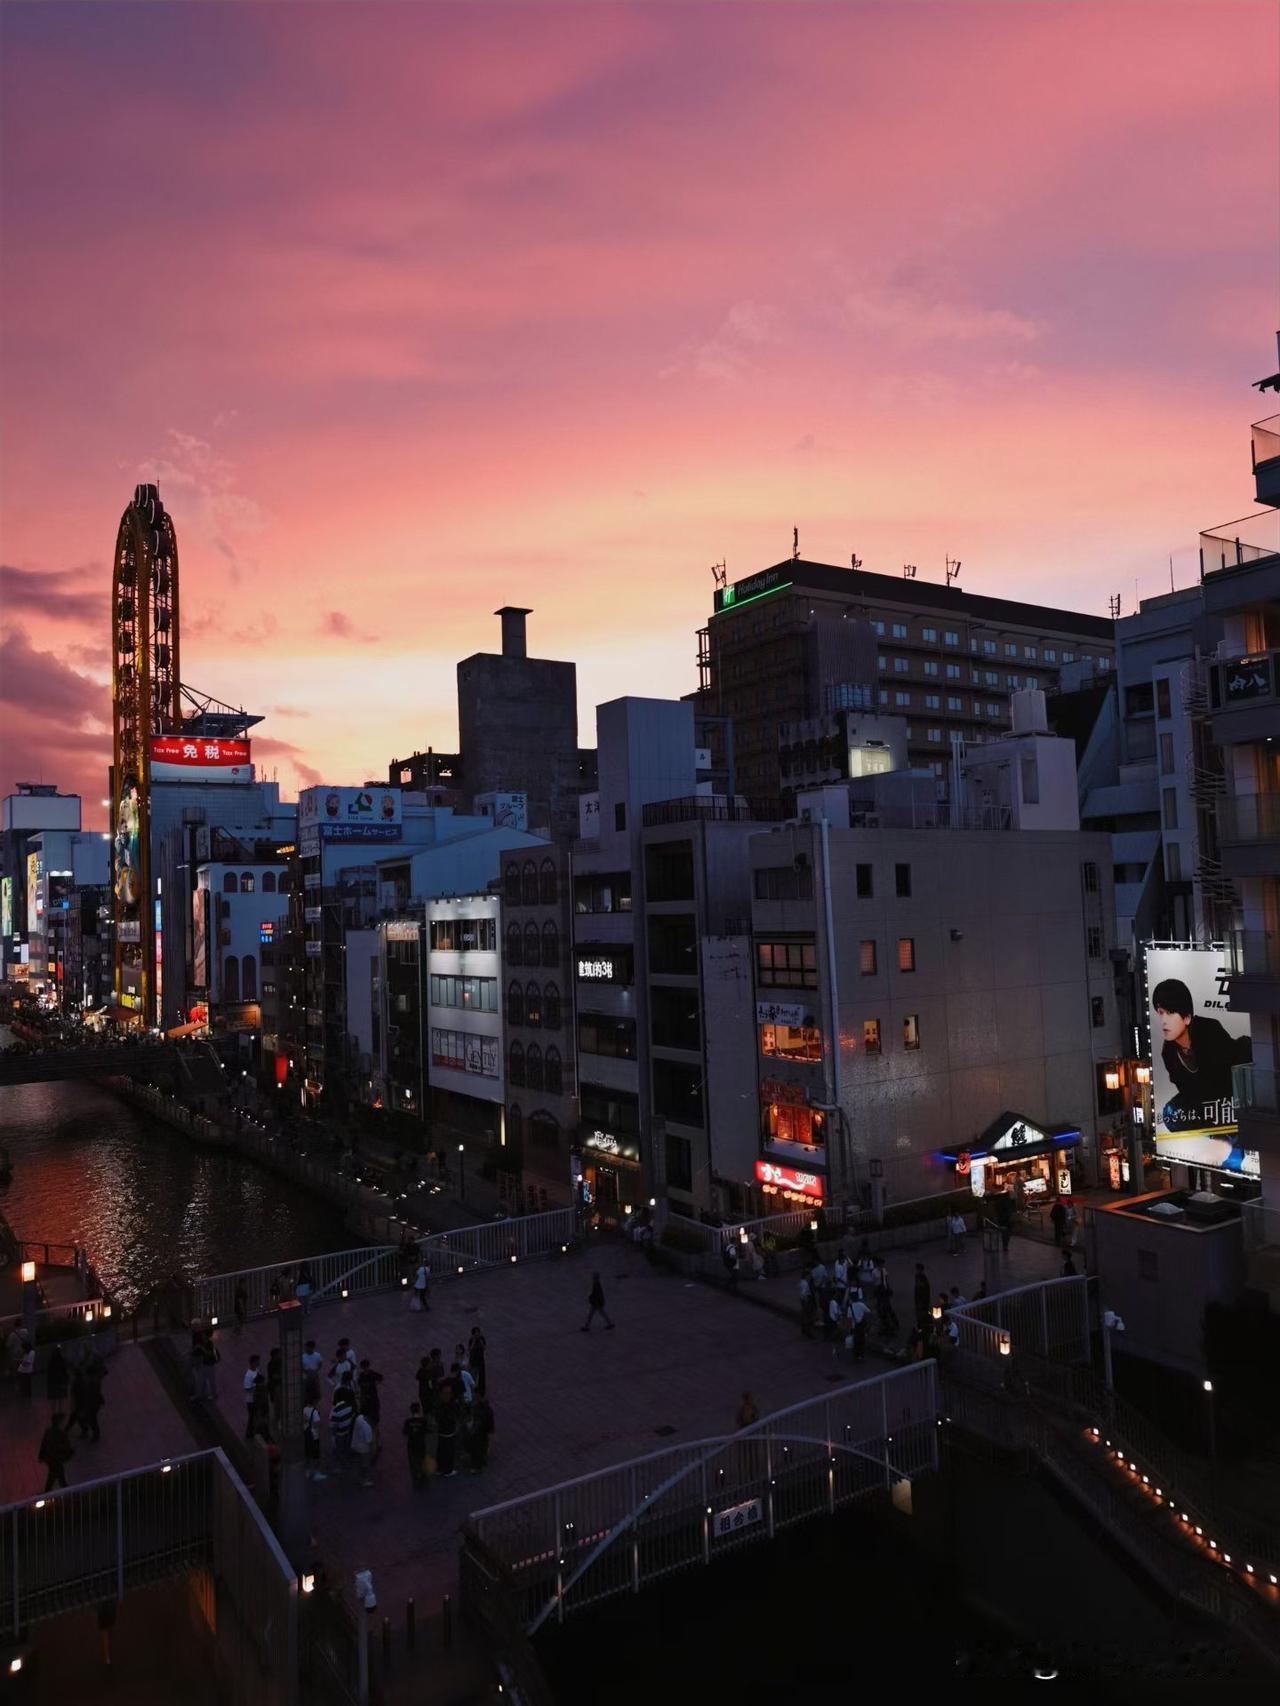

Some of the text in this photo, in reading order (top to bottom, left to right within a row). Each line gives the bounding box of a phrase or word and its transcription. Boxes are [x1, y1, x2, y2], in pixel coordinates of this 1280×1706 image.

[737, 575, 766, 597] Holiday
[766, 572, 779, 585] Inn
[165, 747, 180, 755] Free
[183, 744, 220, 760] 免税
[222, 749, 234, 757] Tax
[322, 825, 398, 837] 富士ホームサービス
